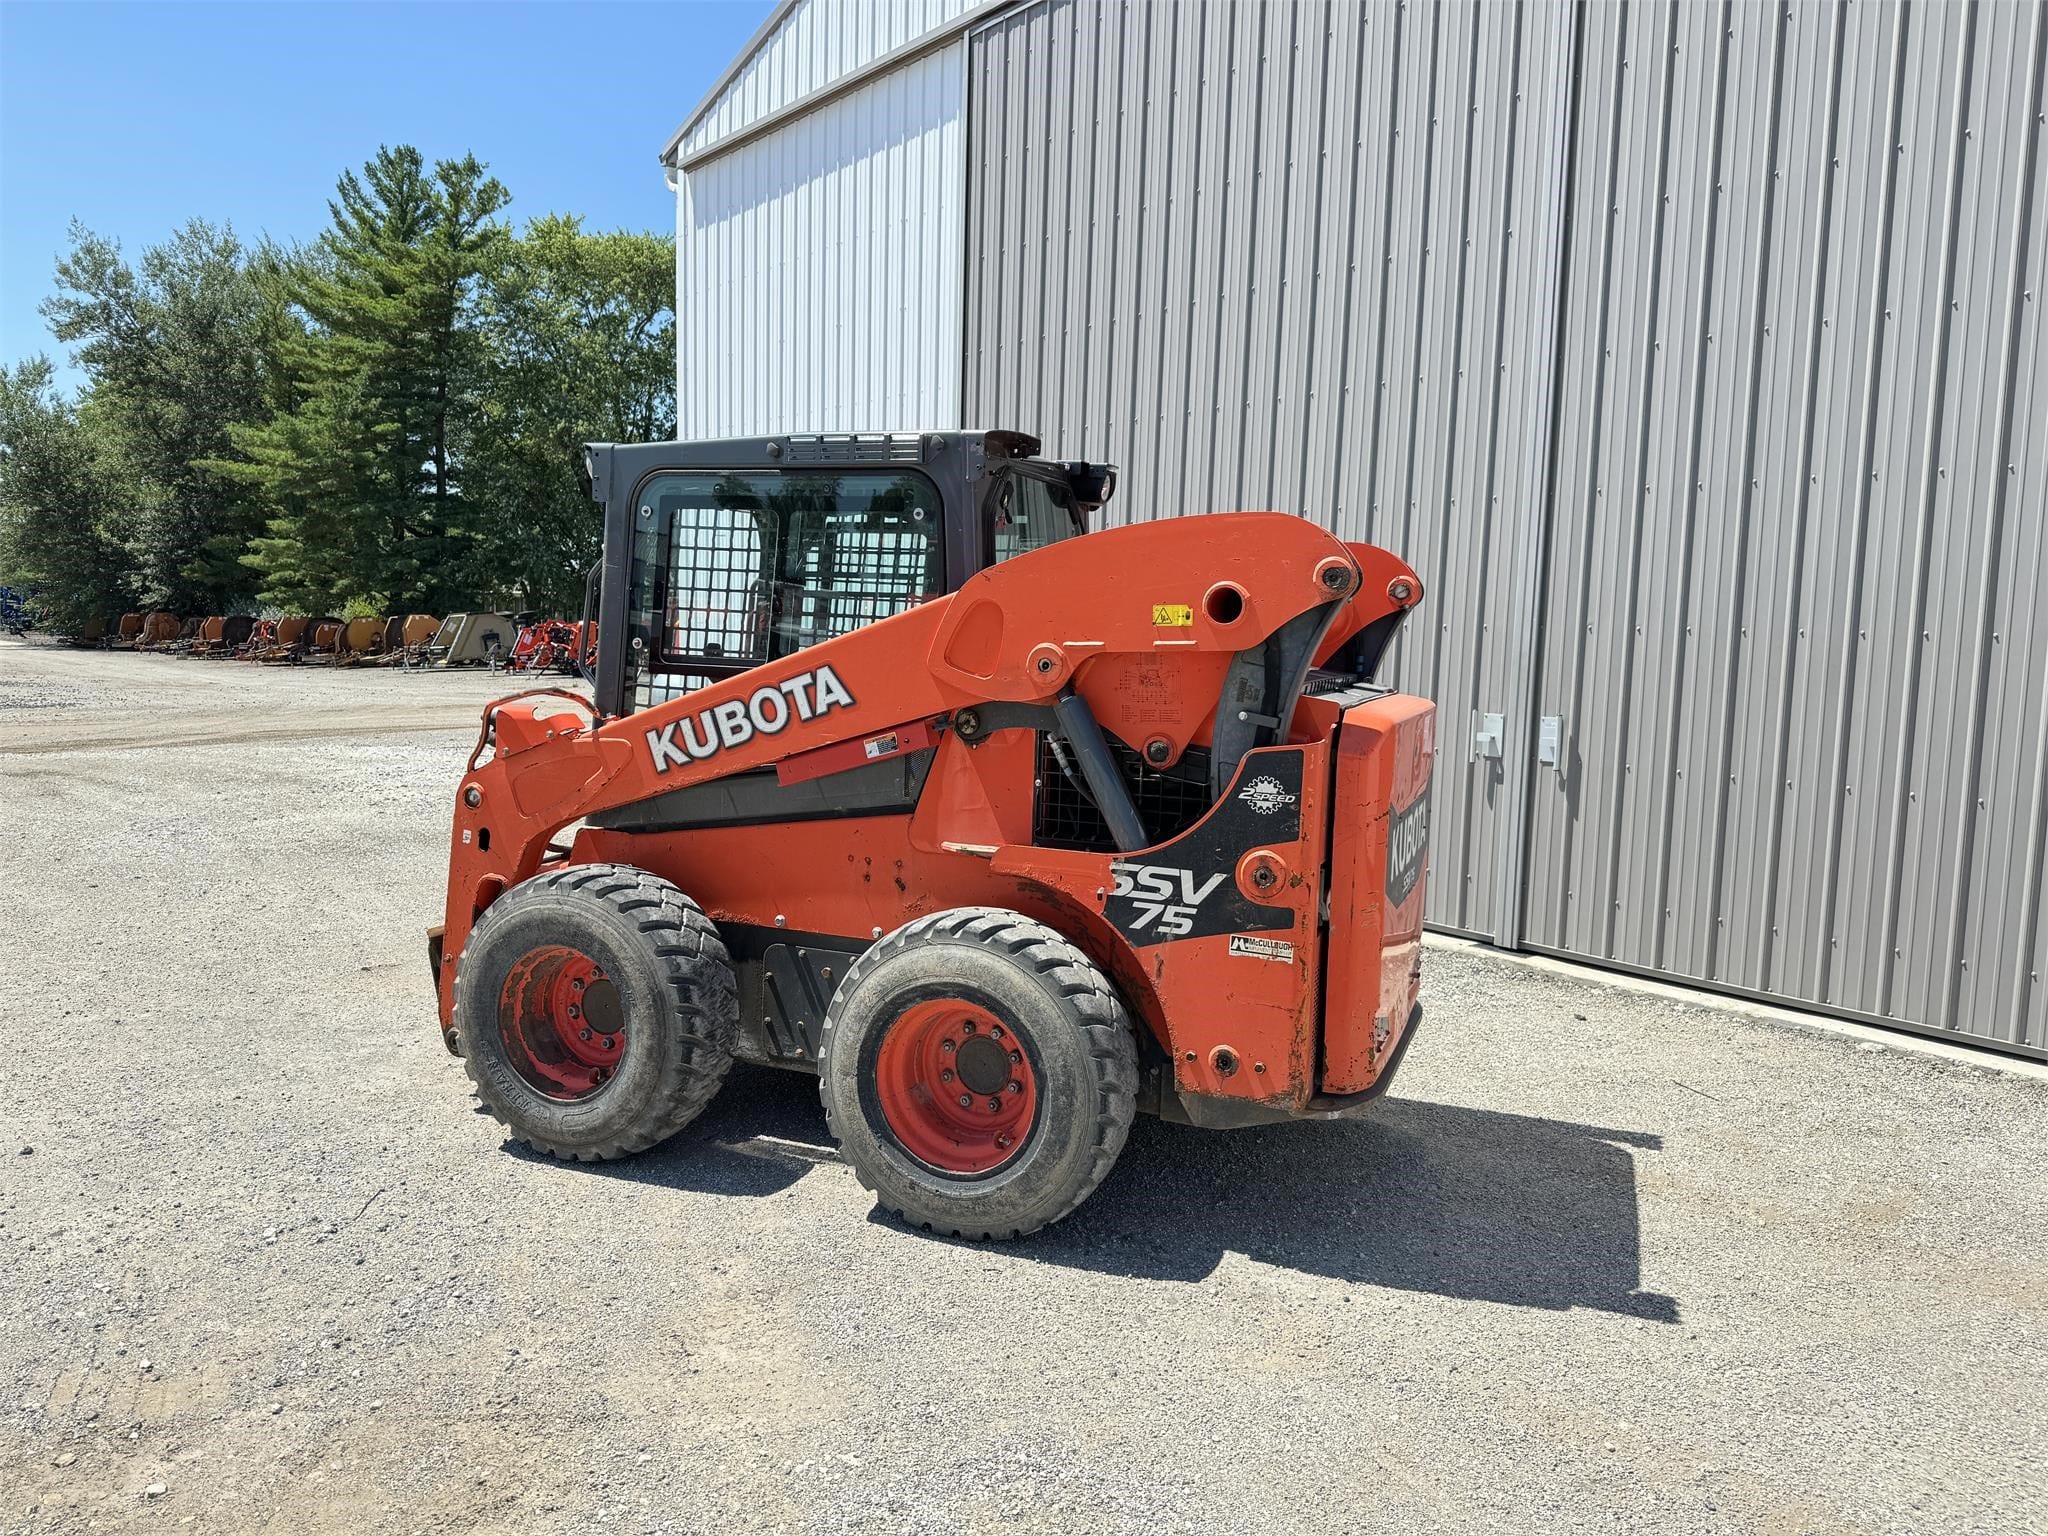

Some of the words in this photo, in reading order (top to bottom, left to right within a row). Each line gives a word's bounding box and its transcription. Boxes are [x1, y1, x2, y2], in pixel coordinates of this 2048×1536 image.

[646, 665, 854, 773] KUBOTA
[1391, 799, 1427, 883] KUBOTA
[1128, 901, 1199, 936] 75
